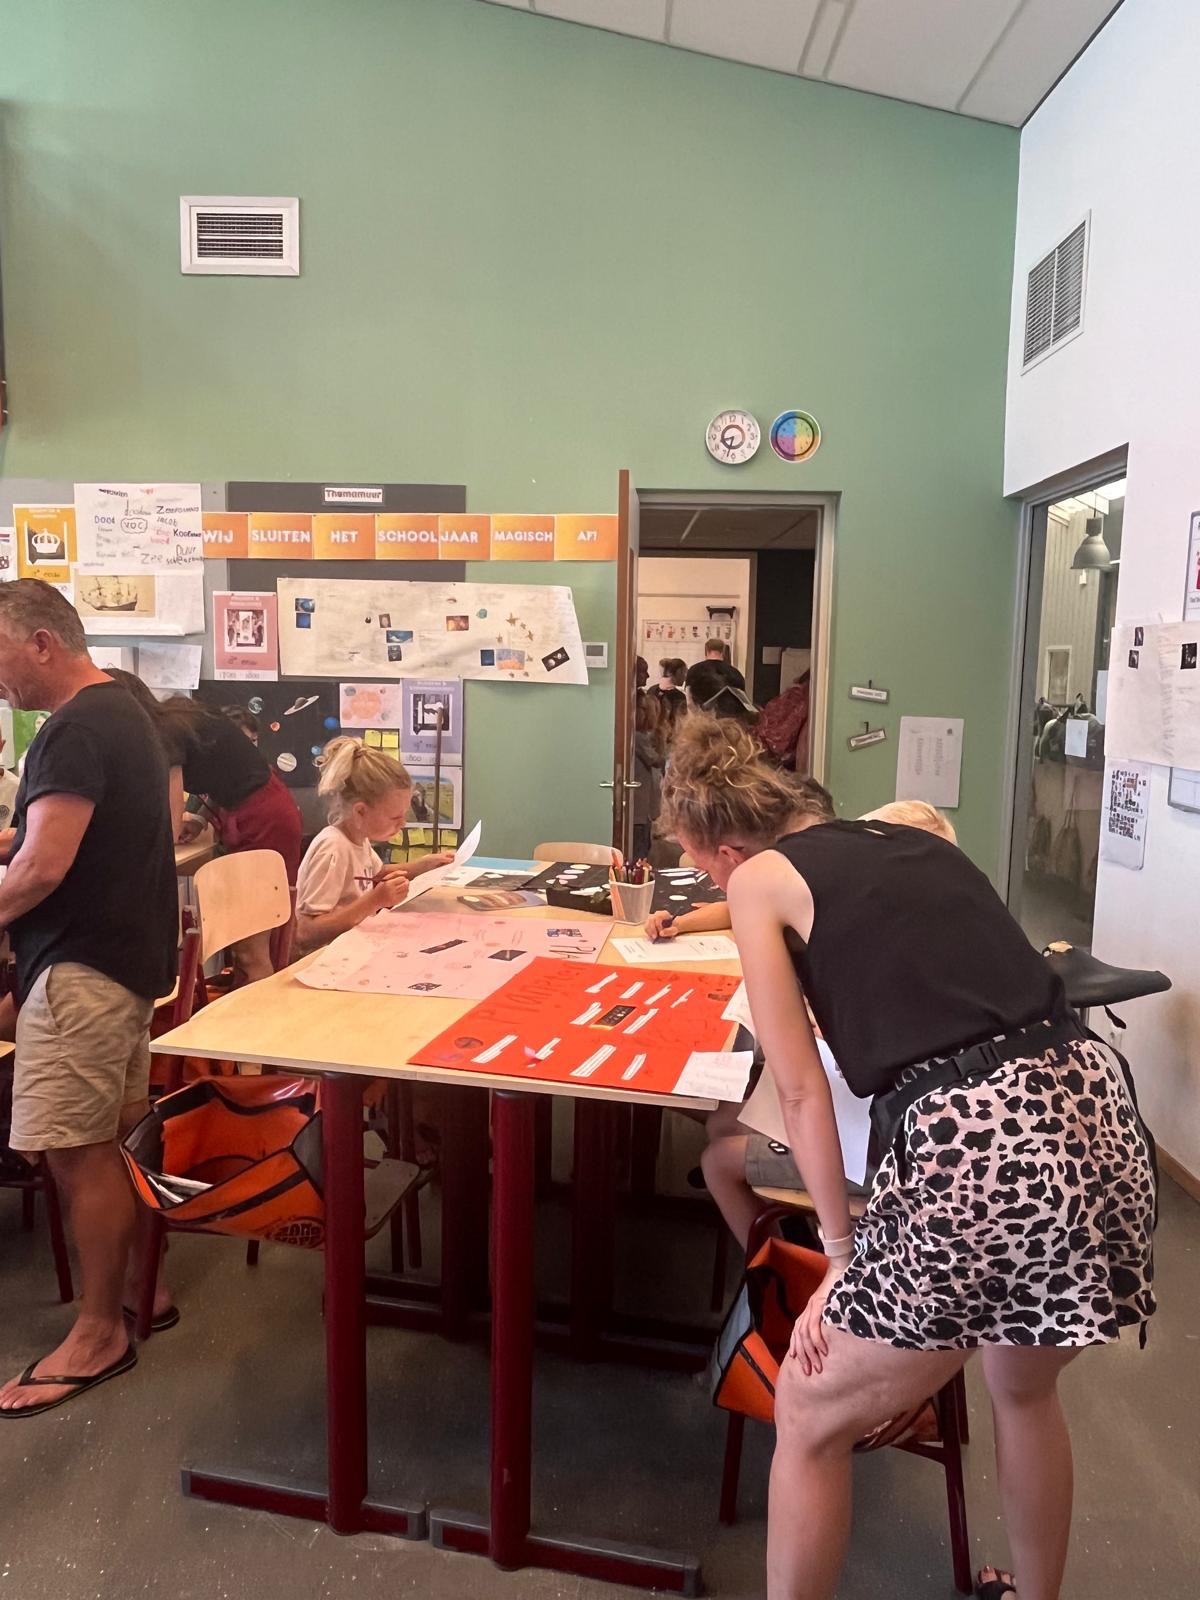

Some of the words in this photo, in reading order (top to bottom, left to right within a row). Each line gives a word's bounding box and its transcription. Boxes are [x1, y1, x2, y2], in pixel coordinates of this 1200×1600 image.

[728, 414, 737, 423] 12
[203, 530, 234, 543] WIJ
[251, 529, 311, 543] SLUITEN
[330, 530, 358, 543] HET
[494, 531, 553, 542] MAGISCH
